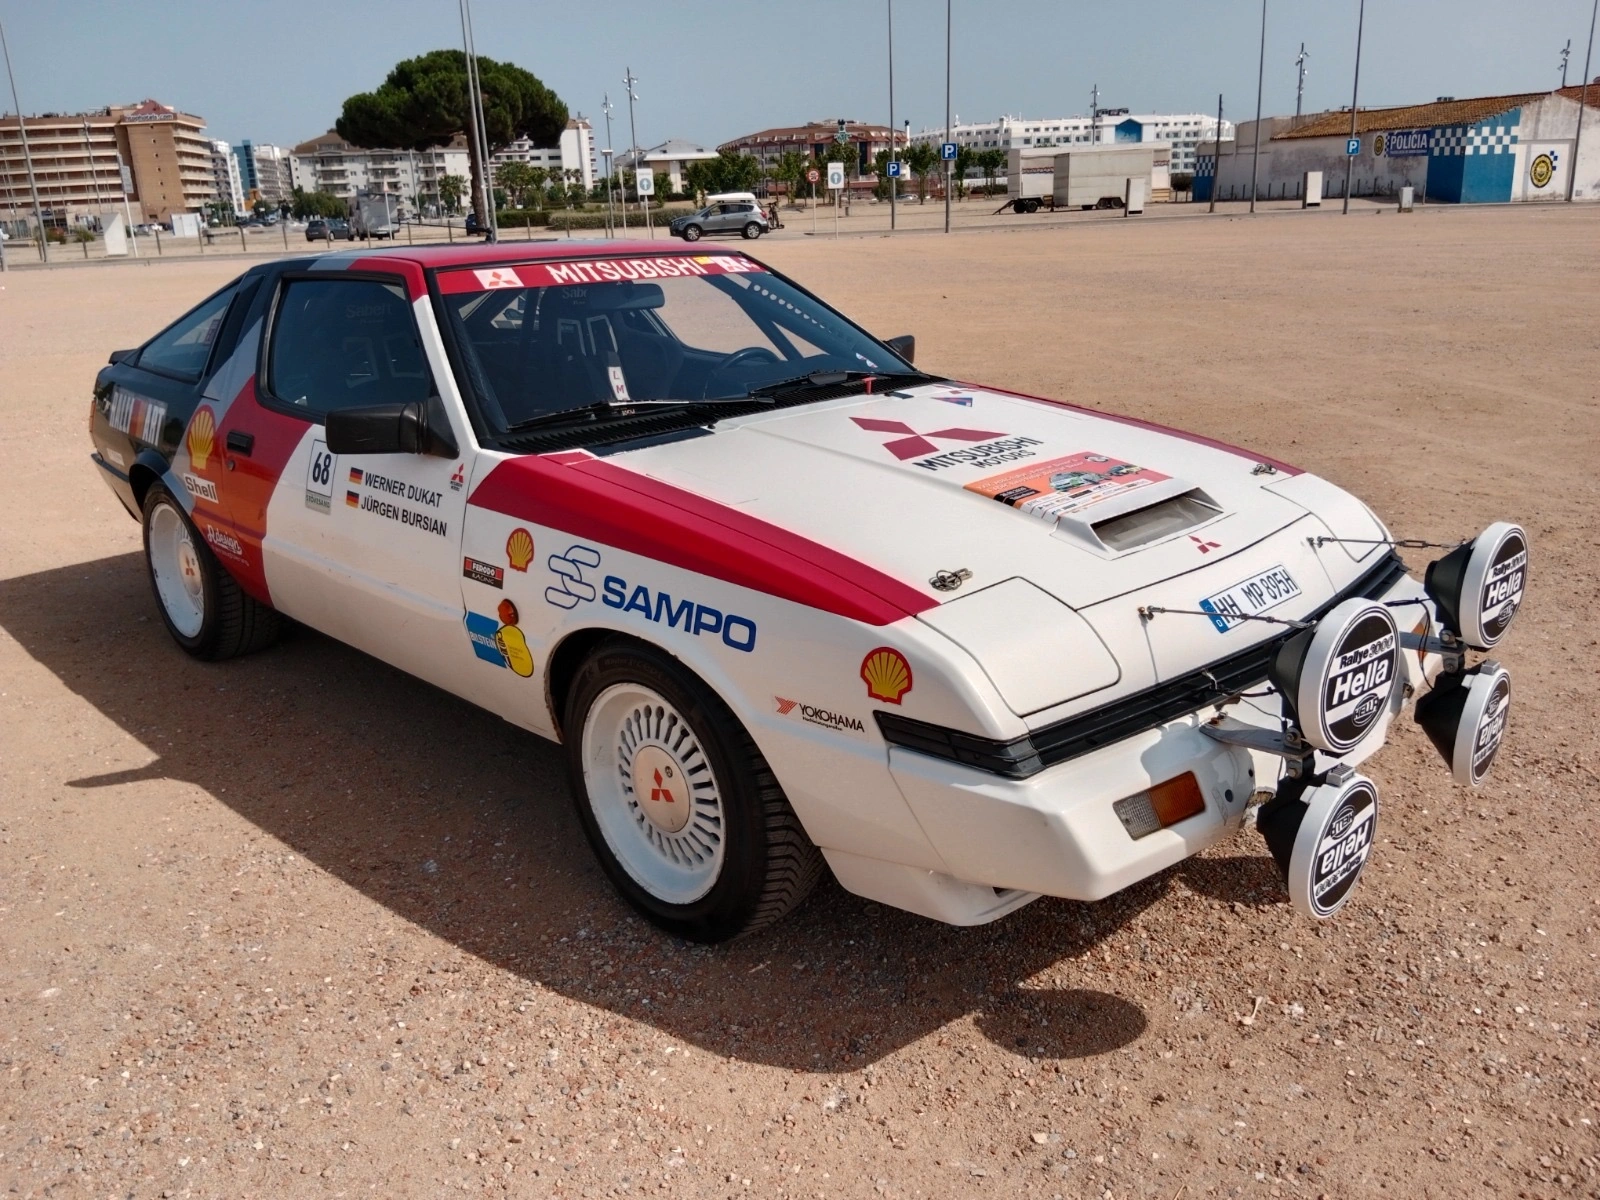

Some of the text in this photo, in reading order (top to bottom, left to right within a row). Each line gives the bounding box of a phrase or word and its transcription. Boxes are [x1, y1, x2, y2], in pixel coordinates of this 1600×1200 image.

[943, 145, 955, 158] P
[1348, 141, 1358, 153] P
[889, 164, 898, 176] P
[546, 257, 709, 284] MITSUBISHI
[312, 451, 332, 486] 68
[911, 436, 1044, 471] MITSUBISHI
[969, 449, 1036, 469] MOTORS
[184, 476, 217, 501] Shell
[365, 472, 443, 508] WERNER DUKAT
[361, 495, 448, 537] JÜRGEN BURSIAN
[472, 562, 496, 577] FERODO
[1213, 569, 1299, 624] HH MP 895H
[1485, 570, 1522, 608] Hella
[602, 574, 757, 653] SAMPO
[1338, 634, 1394, 670] Rallye 3000
[1331, 659, 1389, 706] Hella
[799, 702, 865, 733] YOKOHAMA
[1353, 696, 1379, 719] HELLA
[1320, 820, 1370, 876] Hella
